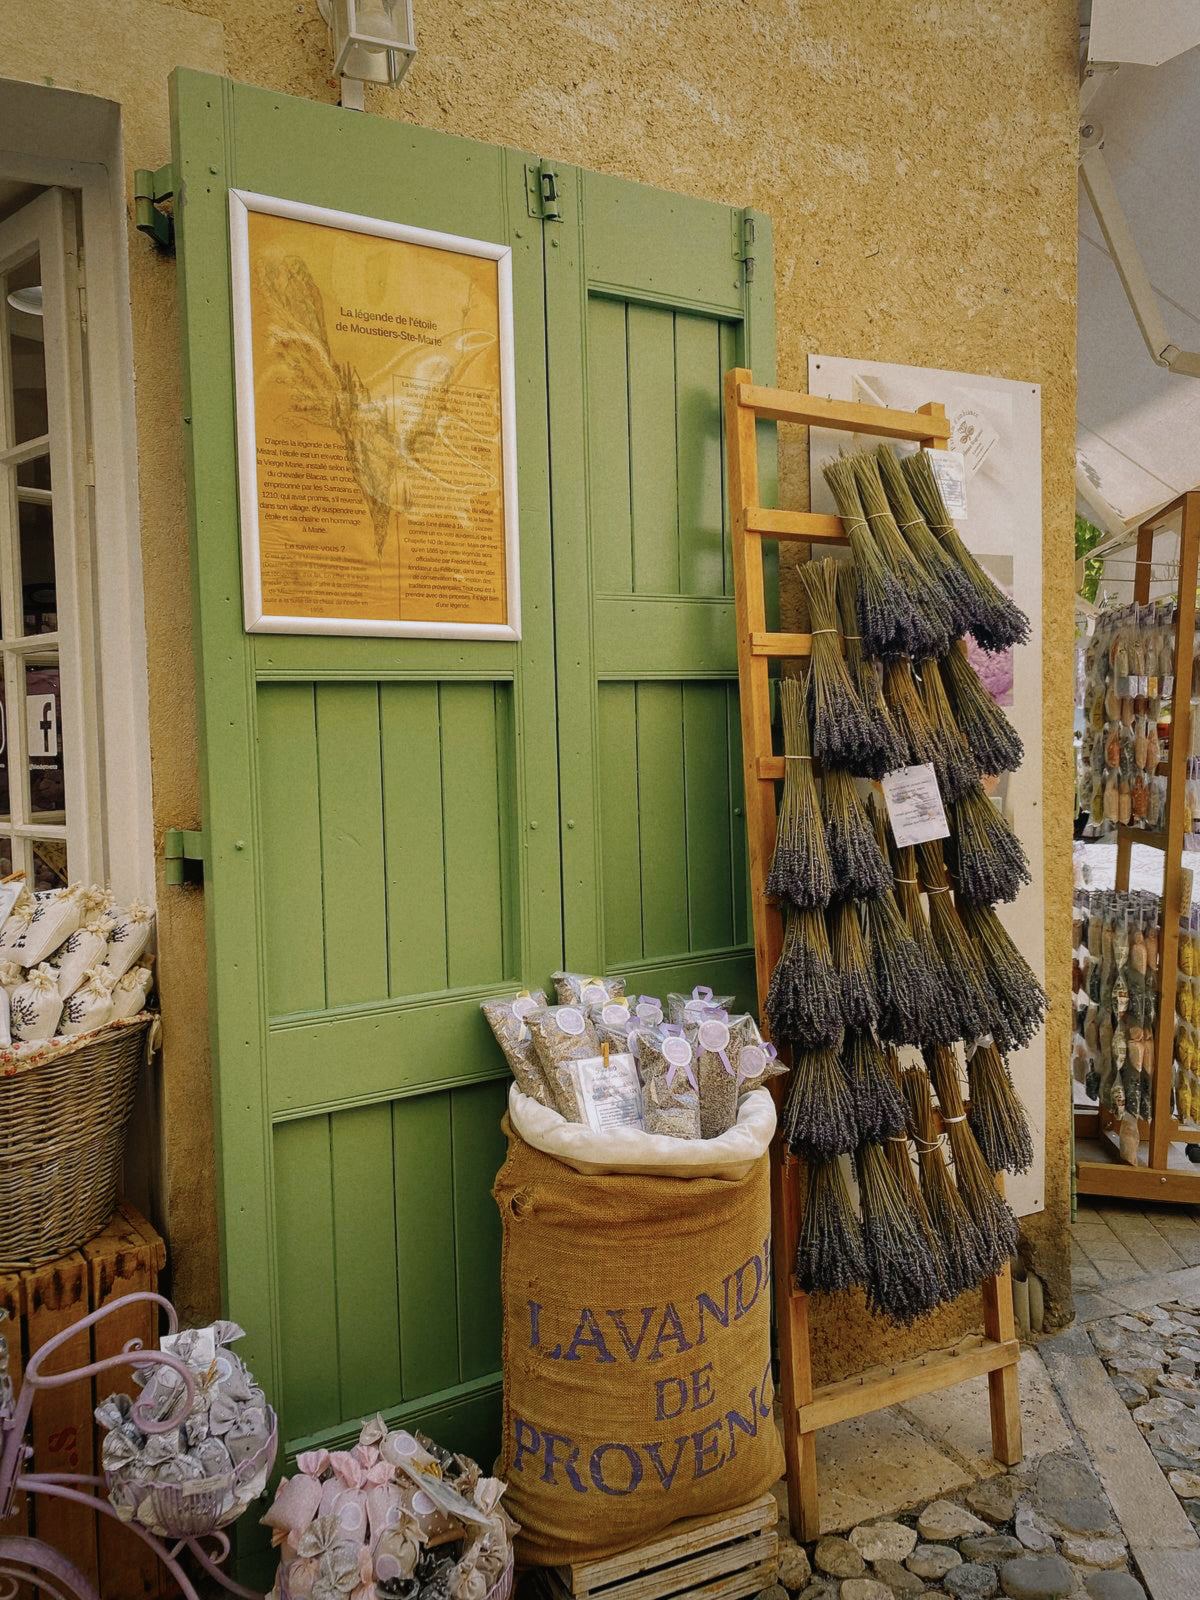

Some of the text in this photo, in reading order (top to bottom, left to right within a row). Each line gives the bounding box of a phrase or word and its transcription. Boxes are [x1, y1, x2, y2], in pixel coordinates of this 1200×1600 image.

[341, 307, 437, 330] La légende de l'étoile
[336, 322, 442, 346] de Moustiers-Ste-Marie
[295, 542, 339, 552] saviez-vous
[40, 702, 52, 752] f
[655, 1361, 716, 1422] DE
